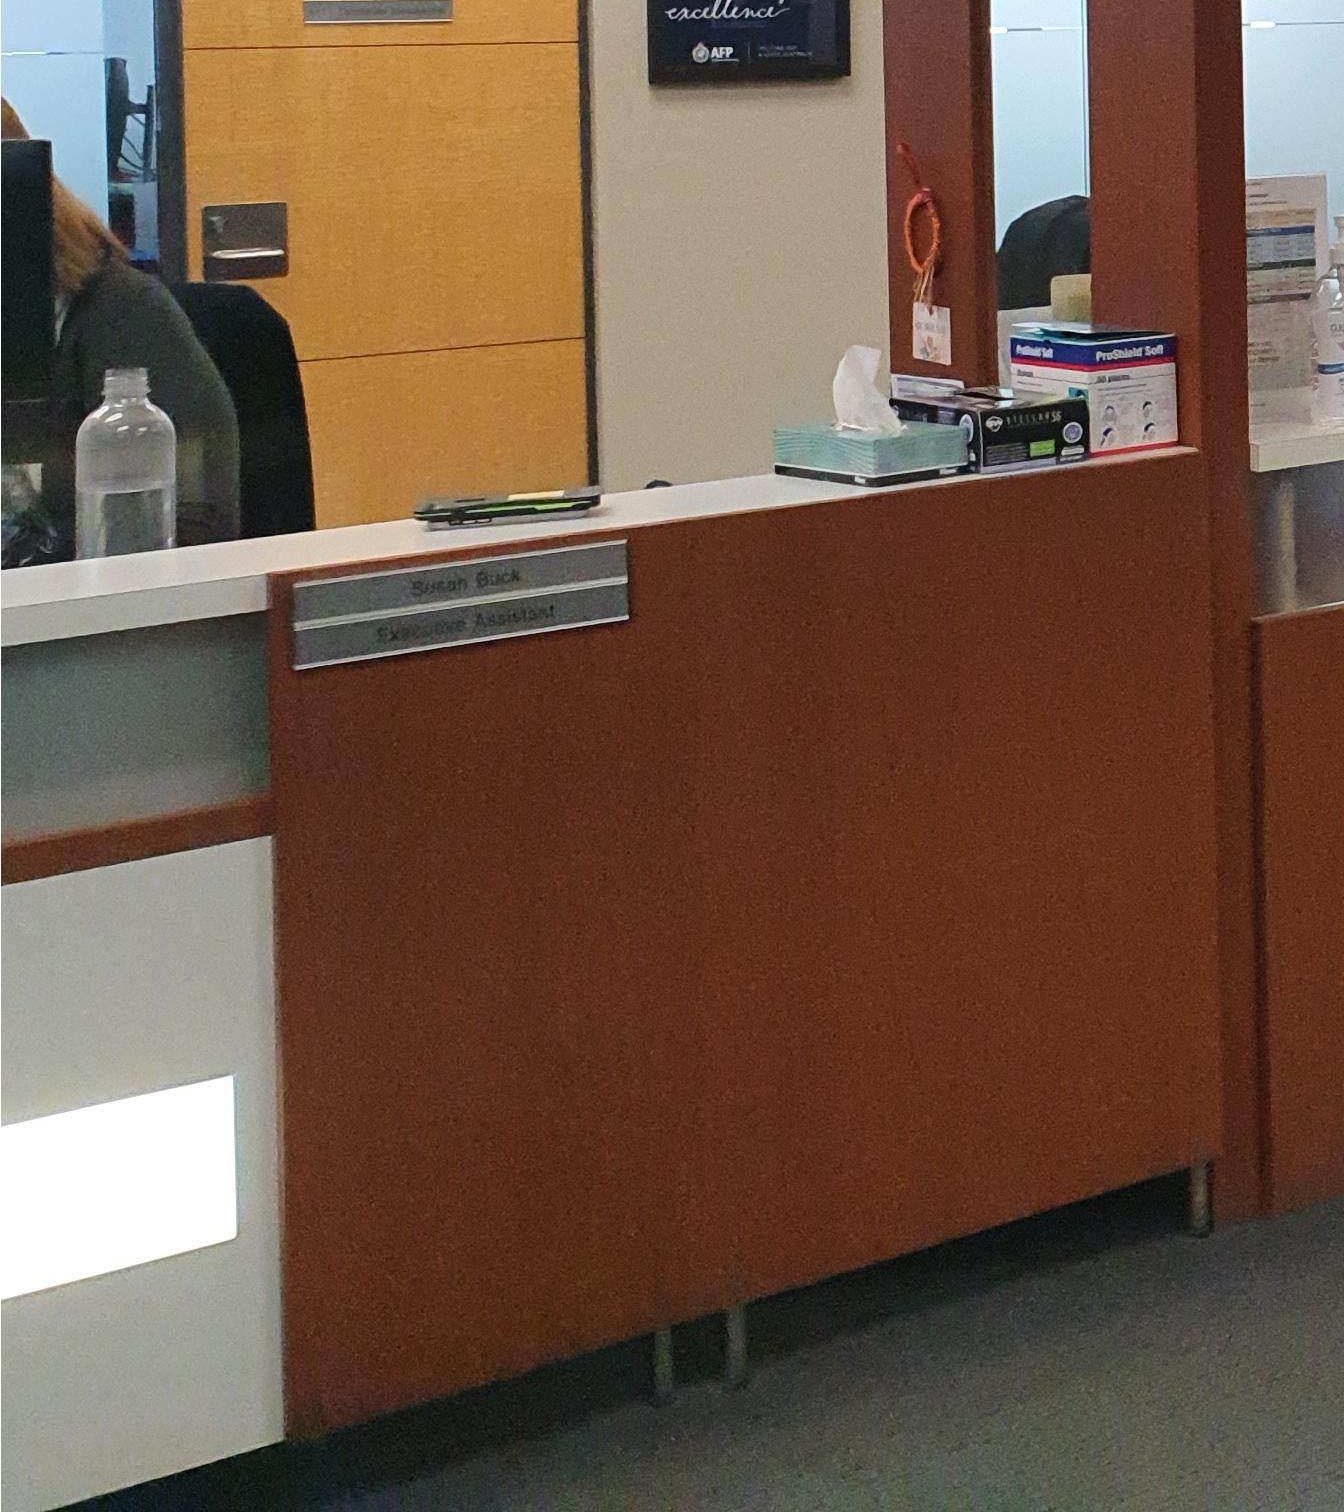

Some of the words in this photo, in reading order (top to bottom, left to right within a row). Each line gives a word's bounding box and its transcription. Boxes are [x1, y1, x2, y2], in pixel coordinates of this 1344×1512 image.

[711, 46, 734, 59] AFP
[1095, 346, 1143, 363] ProShield
[411, 576, 468, 596] Susan
[475, 568, 521, 588] Buck
